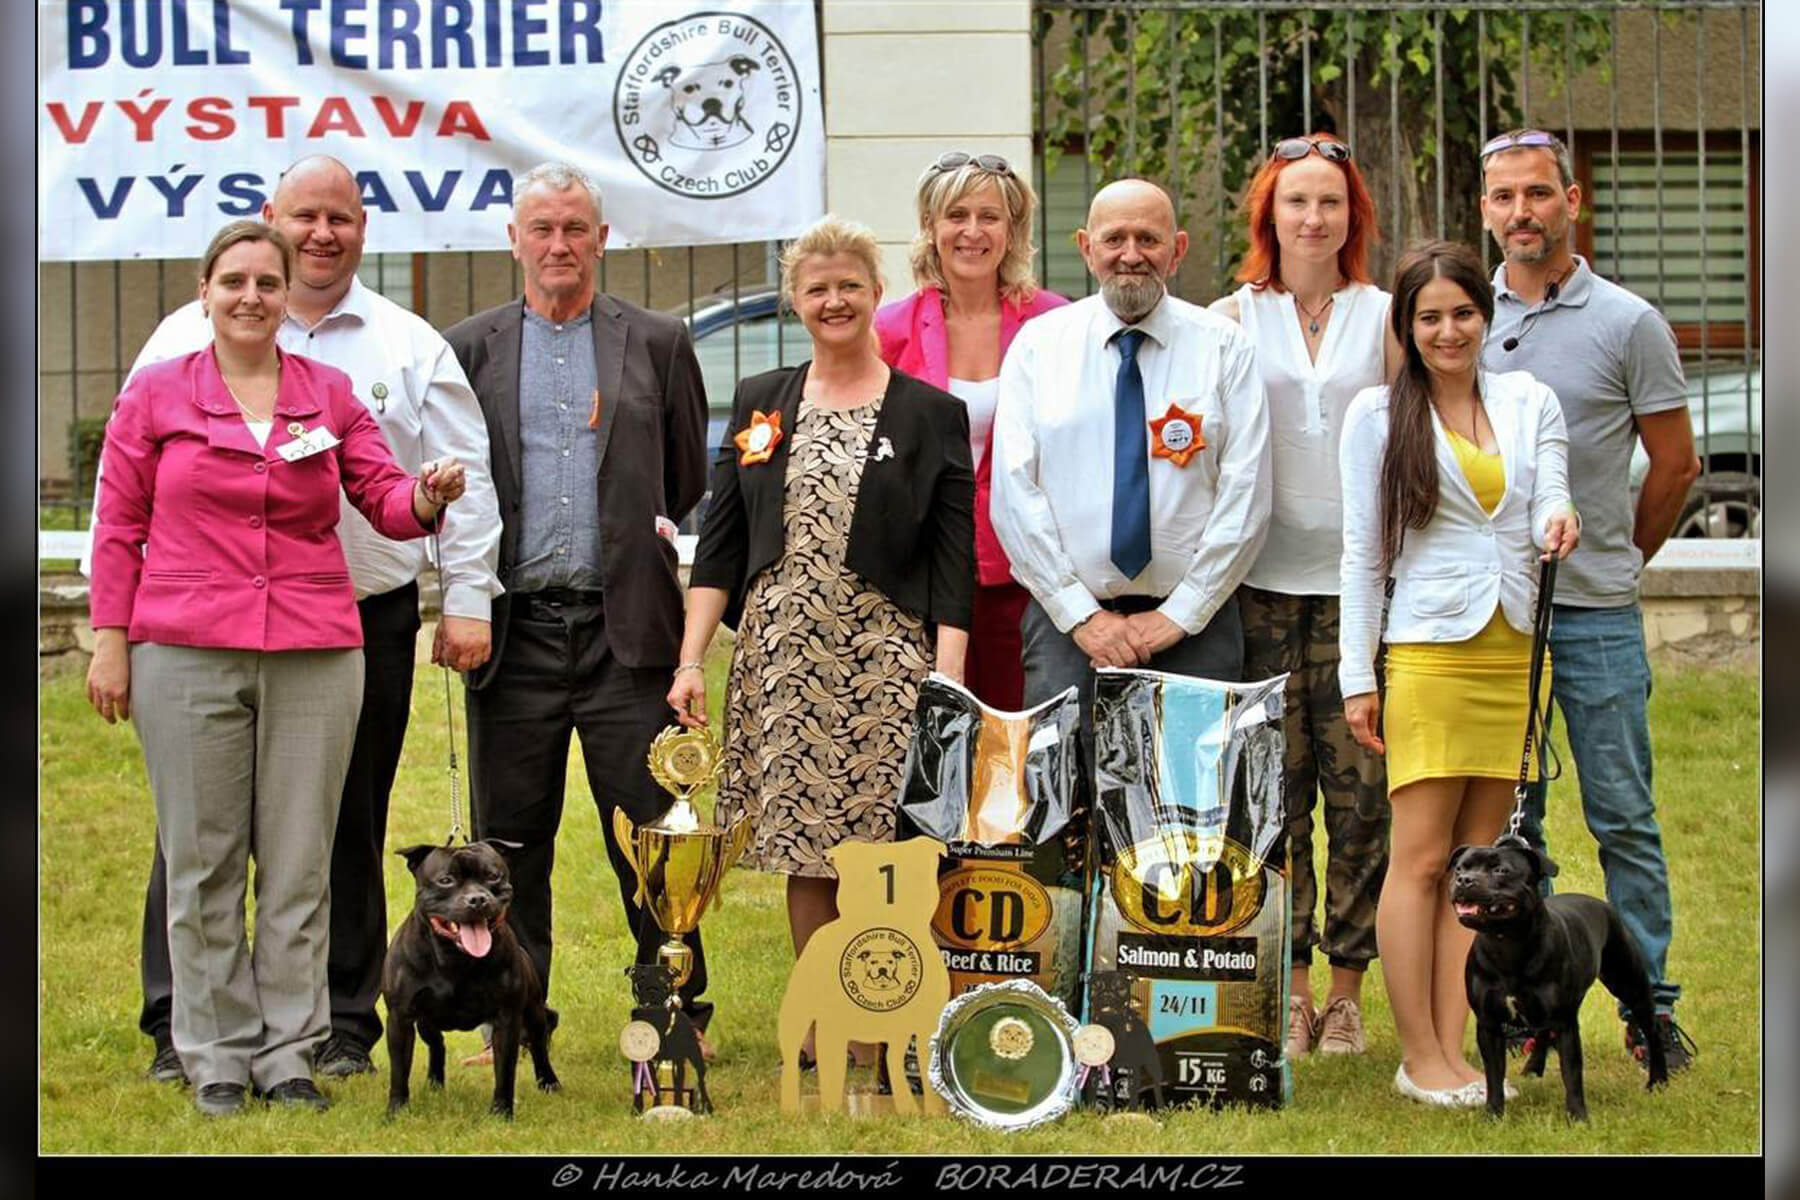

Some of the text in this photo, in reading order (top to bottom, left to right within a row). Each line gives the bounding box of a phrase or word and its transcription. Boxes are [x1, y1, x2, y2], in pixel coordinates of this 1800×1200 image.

[67, 0, 605, 70] BULL TERRIER
[623, 20, 793, 126] Staffordshire Bull Terrier
[45, 88, 491, 144] VÝSTAVA
[76, 164, 513, 220] VÝSAVA
[660, 158, 769, 192] Czech Club
[1015, 848, 1034, 858] Line
[878, 864, 895, 905] 1
[951, 888, 1025, 942] CD
[844, 932, 920, 977] Staffordshire Bull Terrier
[941, 951, 1033, 973] Beef & Rice
[1118, 945, 1256, 969] Salmon & Potato
[856, 993, 906, 1009] Czech Club
[1160, 994, 1206, 1016] 24/11
[1179, 1058, 1227, 1084] 15 KG
